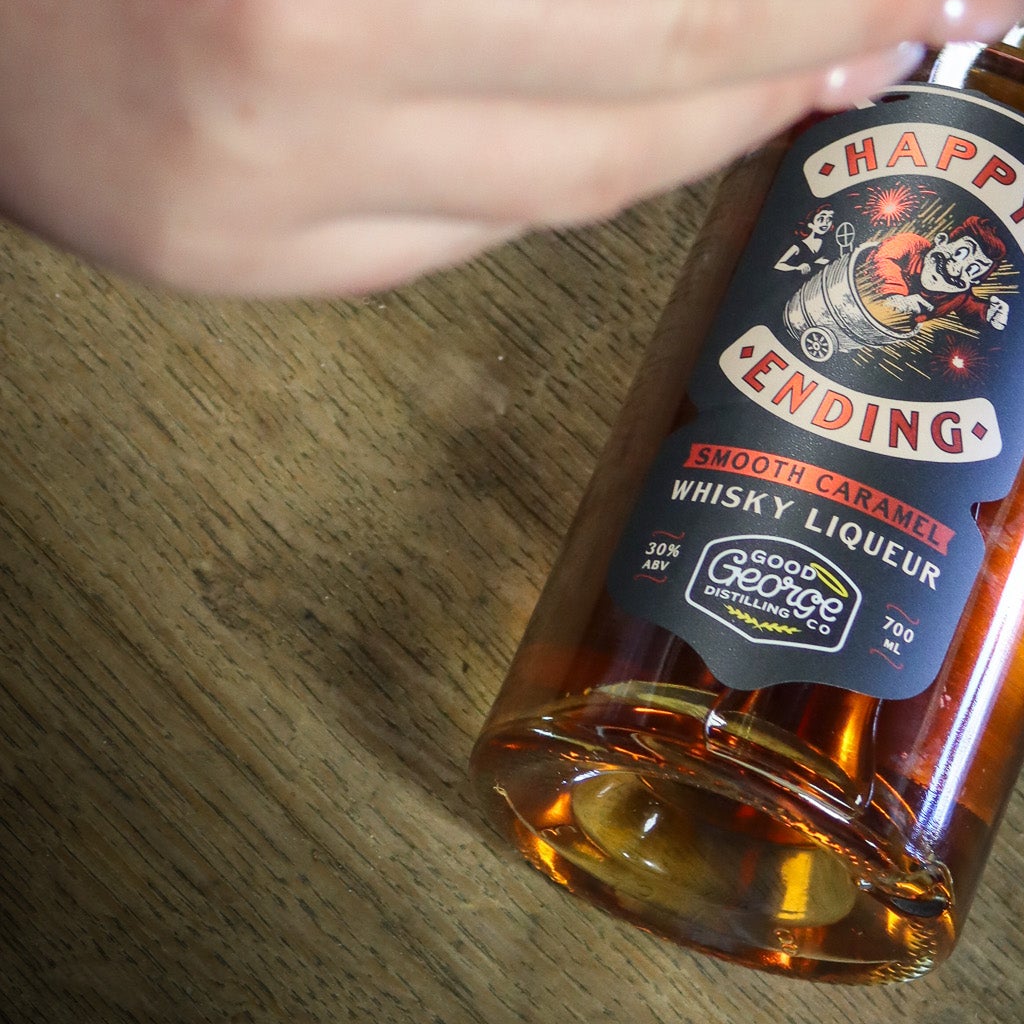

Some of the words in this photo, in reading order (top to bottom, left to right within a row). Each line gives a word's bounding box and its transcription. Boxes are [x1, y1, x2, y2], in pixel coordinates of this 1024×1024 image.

[742, 349, 964, 455] ENDING
[694, 447, 806, 485] SMOOTH
[815, 474, 941, 546] CARAMEL
[645, 541, 681, 558] 30%
[670, 479, 795, 520] WHISKY
[804, 507, 942, 591] LIQUEUR
[642, 559, 670, 572] ABV
[750, 549, 817, 580] GOOD
[708, 548, 844, 623] George
[703, 584, 790, 620] DISTILLING
[806, 618, 831, 636] CO
[883, 616, 914, 644] 700
[883, 639, 902, 655] ML
